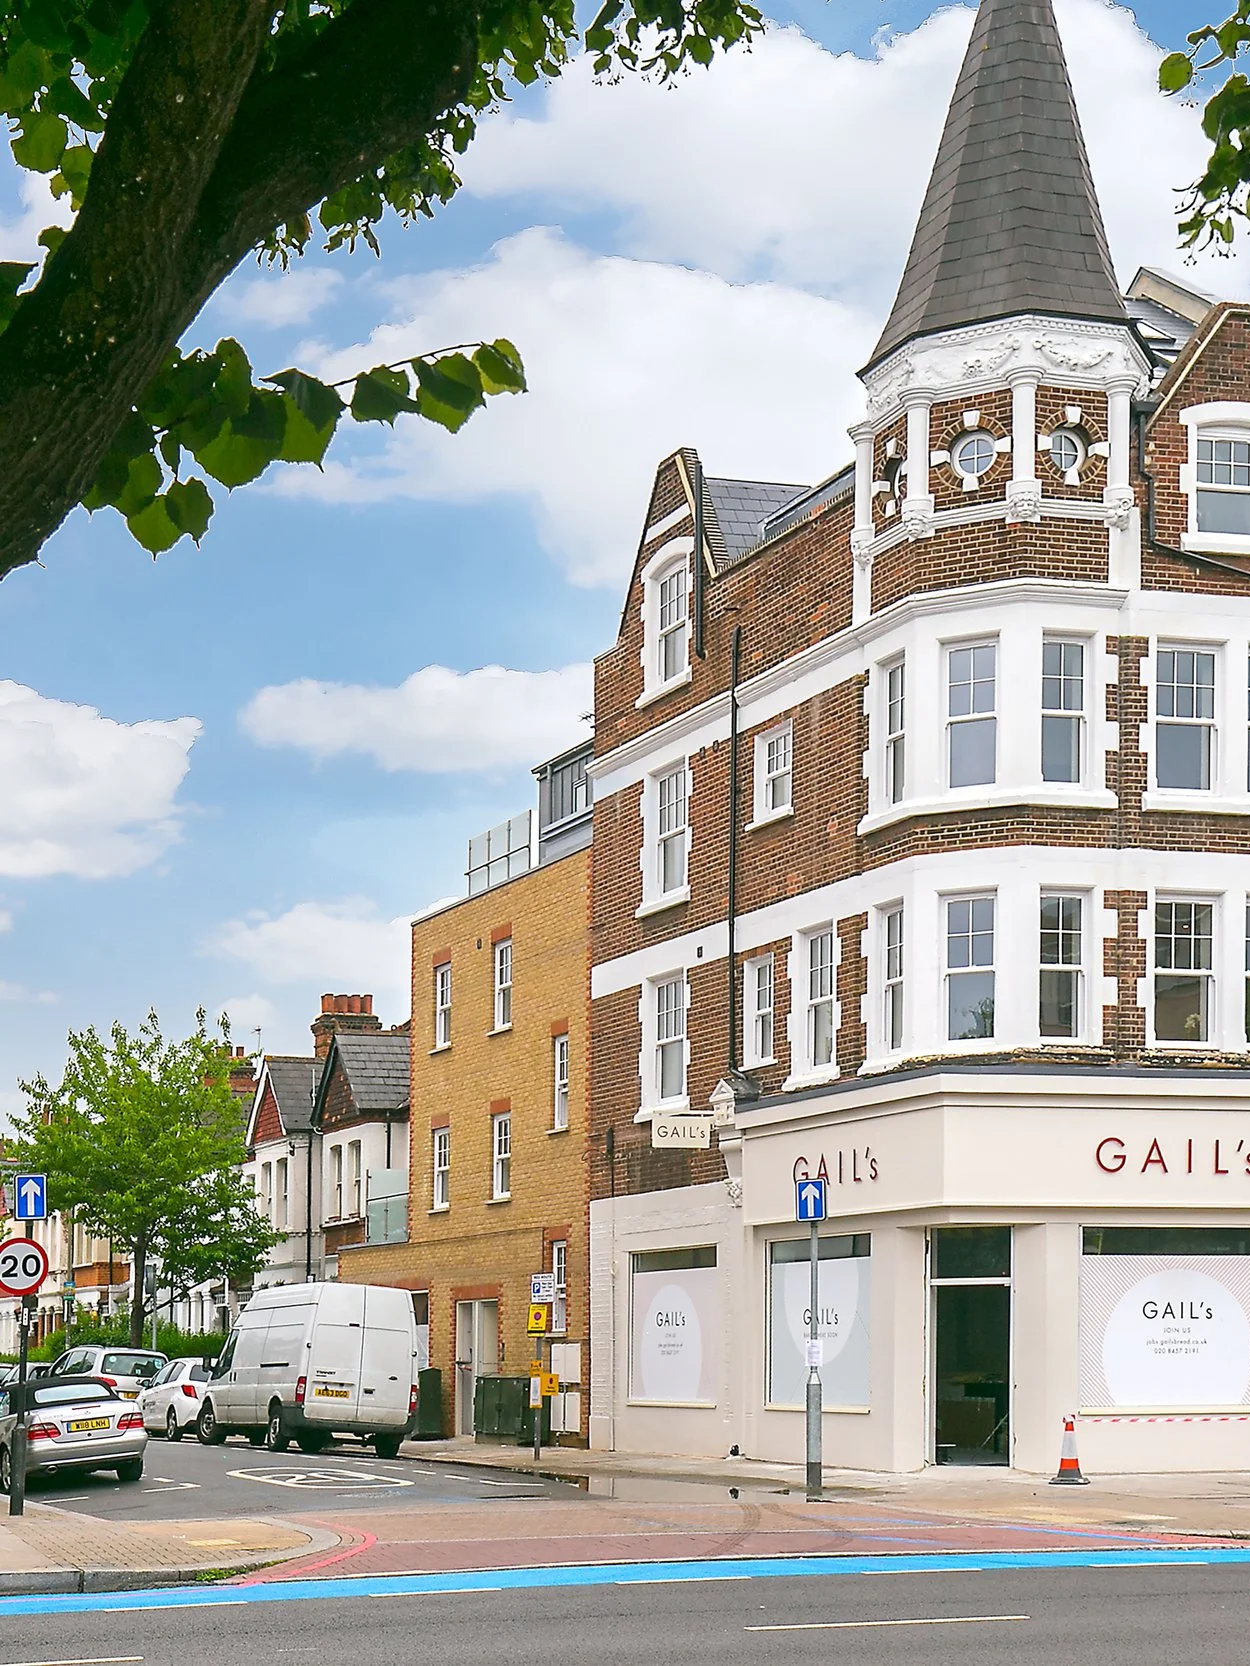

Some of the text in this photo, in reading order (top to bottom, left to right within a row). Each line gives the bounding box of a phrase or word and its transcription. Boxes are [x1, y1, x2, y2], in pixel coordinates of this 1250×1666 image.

[656, 1125, 707, 1140] GAIL's
[1, 1254, 41, 1278] 20
[802, 1308, 839, 1325] GIL's
[1142, 1301, 1213, 1320] GAIL's
[655, 1311, 686, 1327] GAIL's
[91, 1419, 107, 1429] LNH
